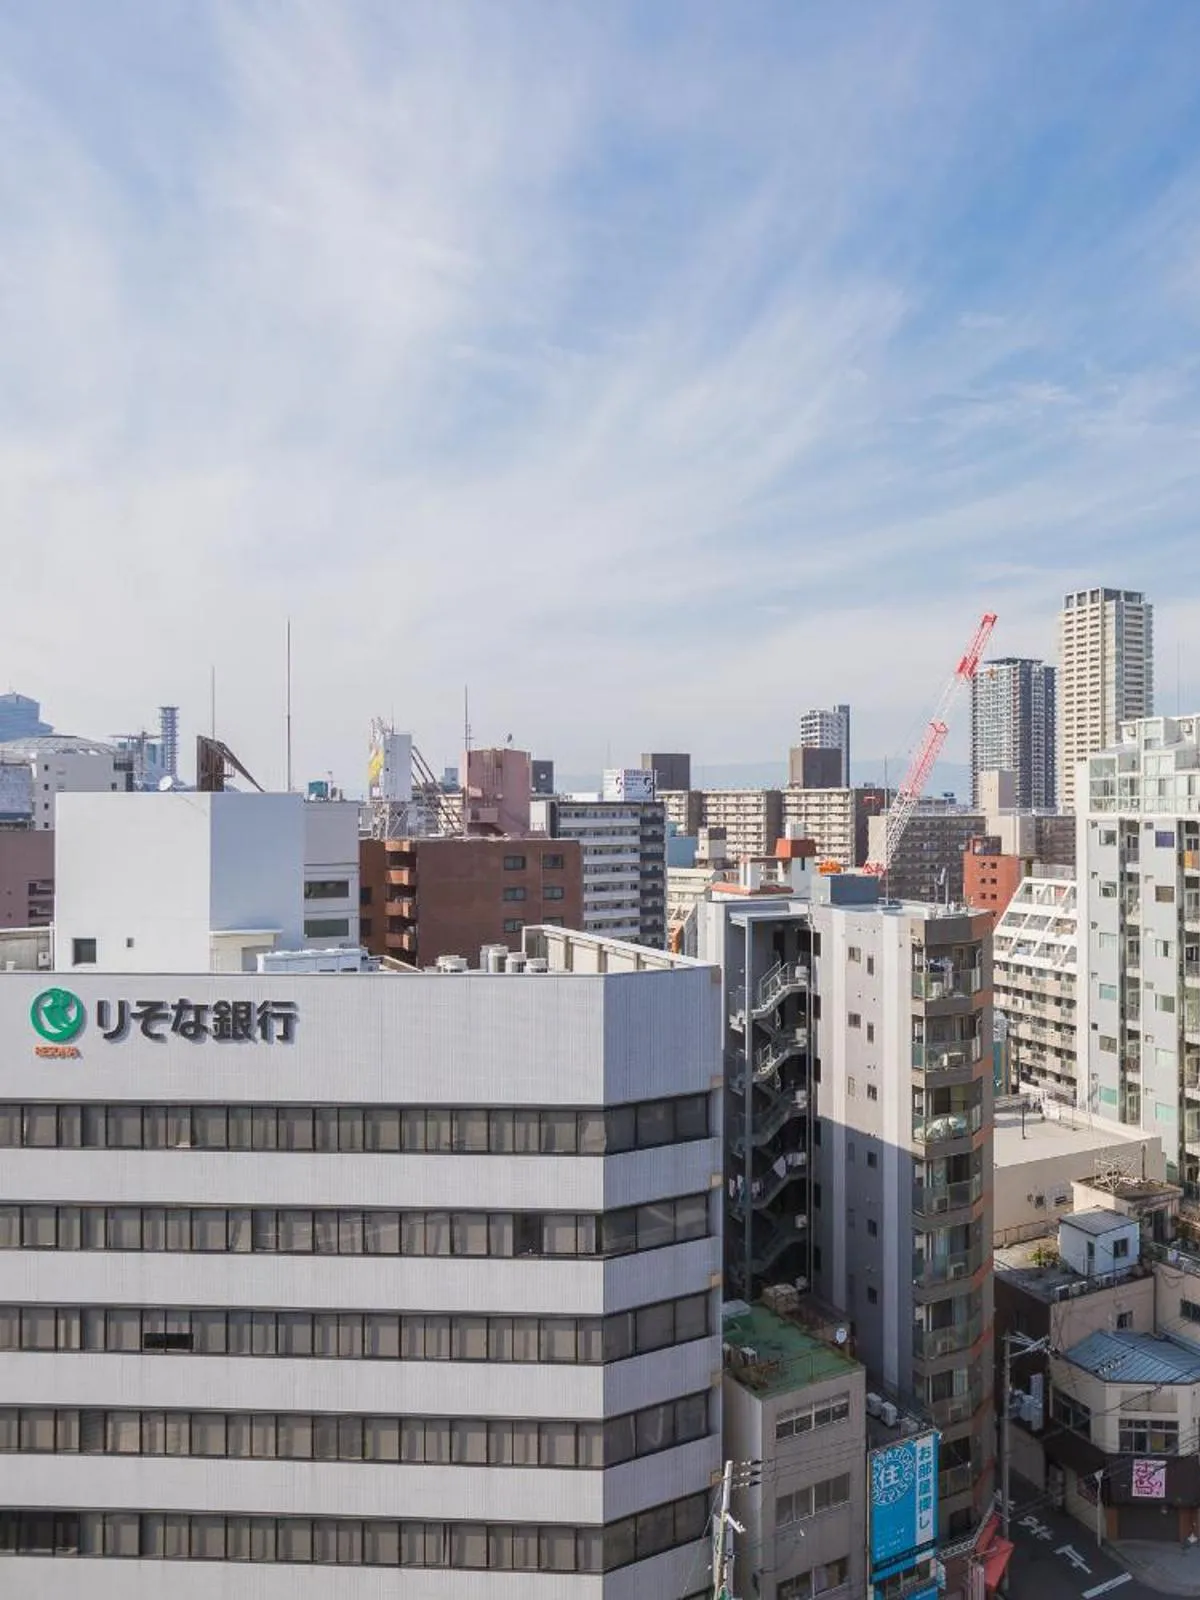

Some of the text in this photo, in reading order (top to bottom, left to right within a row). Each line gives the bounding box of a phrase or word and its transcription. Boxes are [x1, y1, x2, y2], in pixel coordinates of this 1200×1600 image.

[97, 998, 299, 1041] りそな銀行
